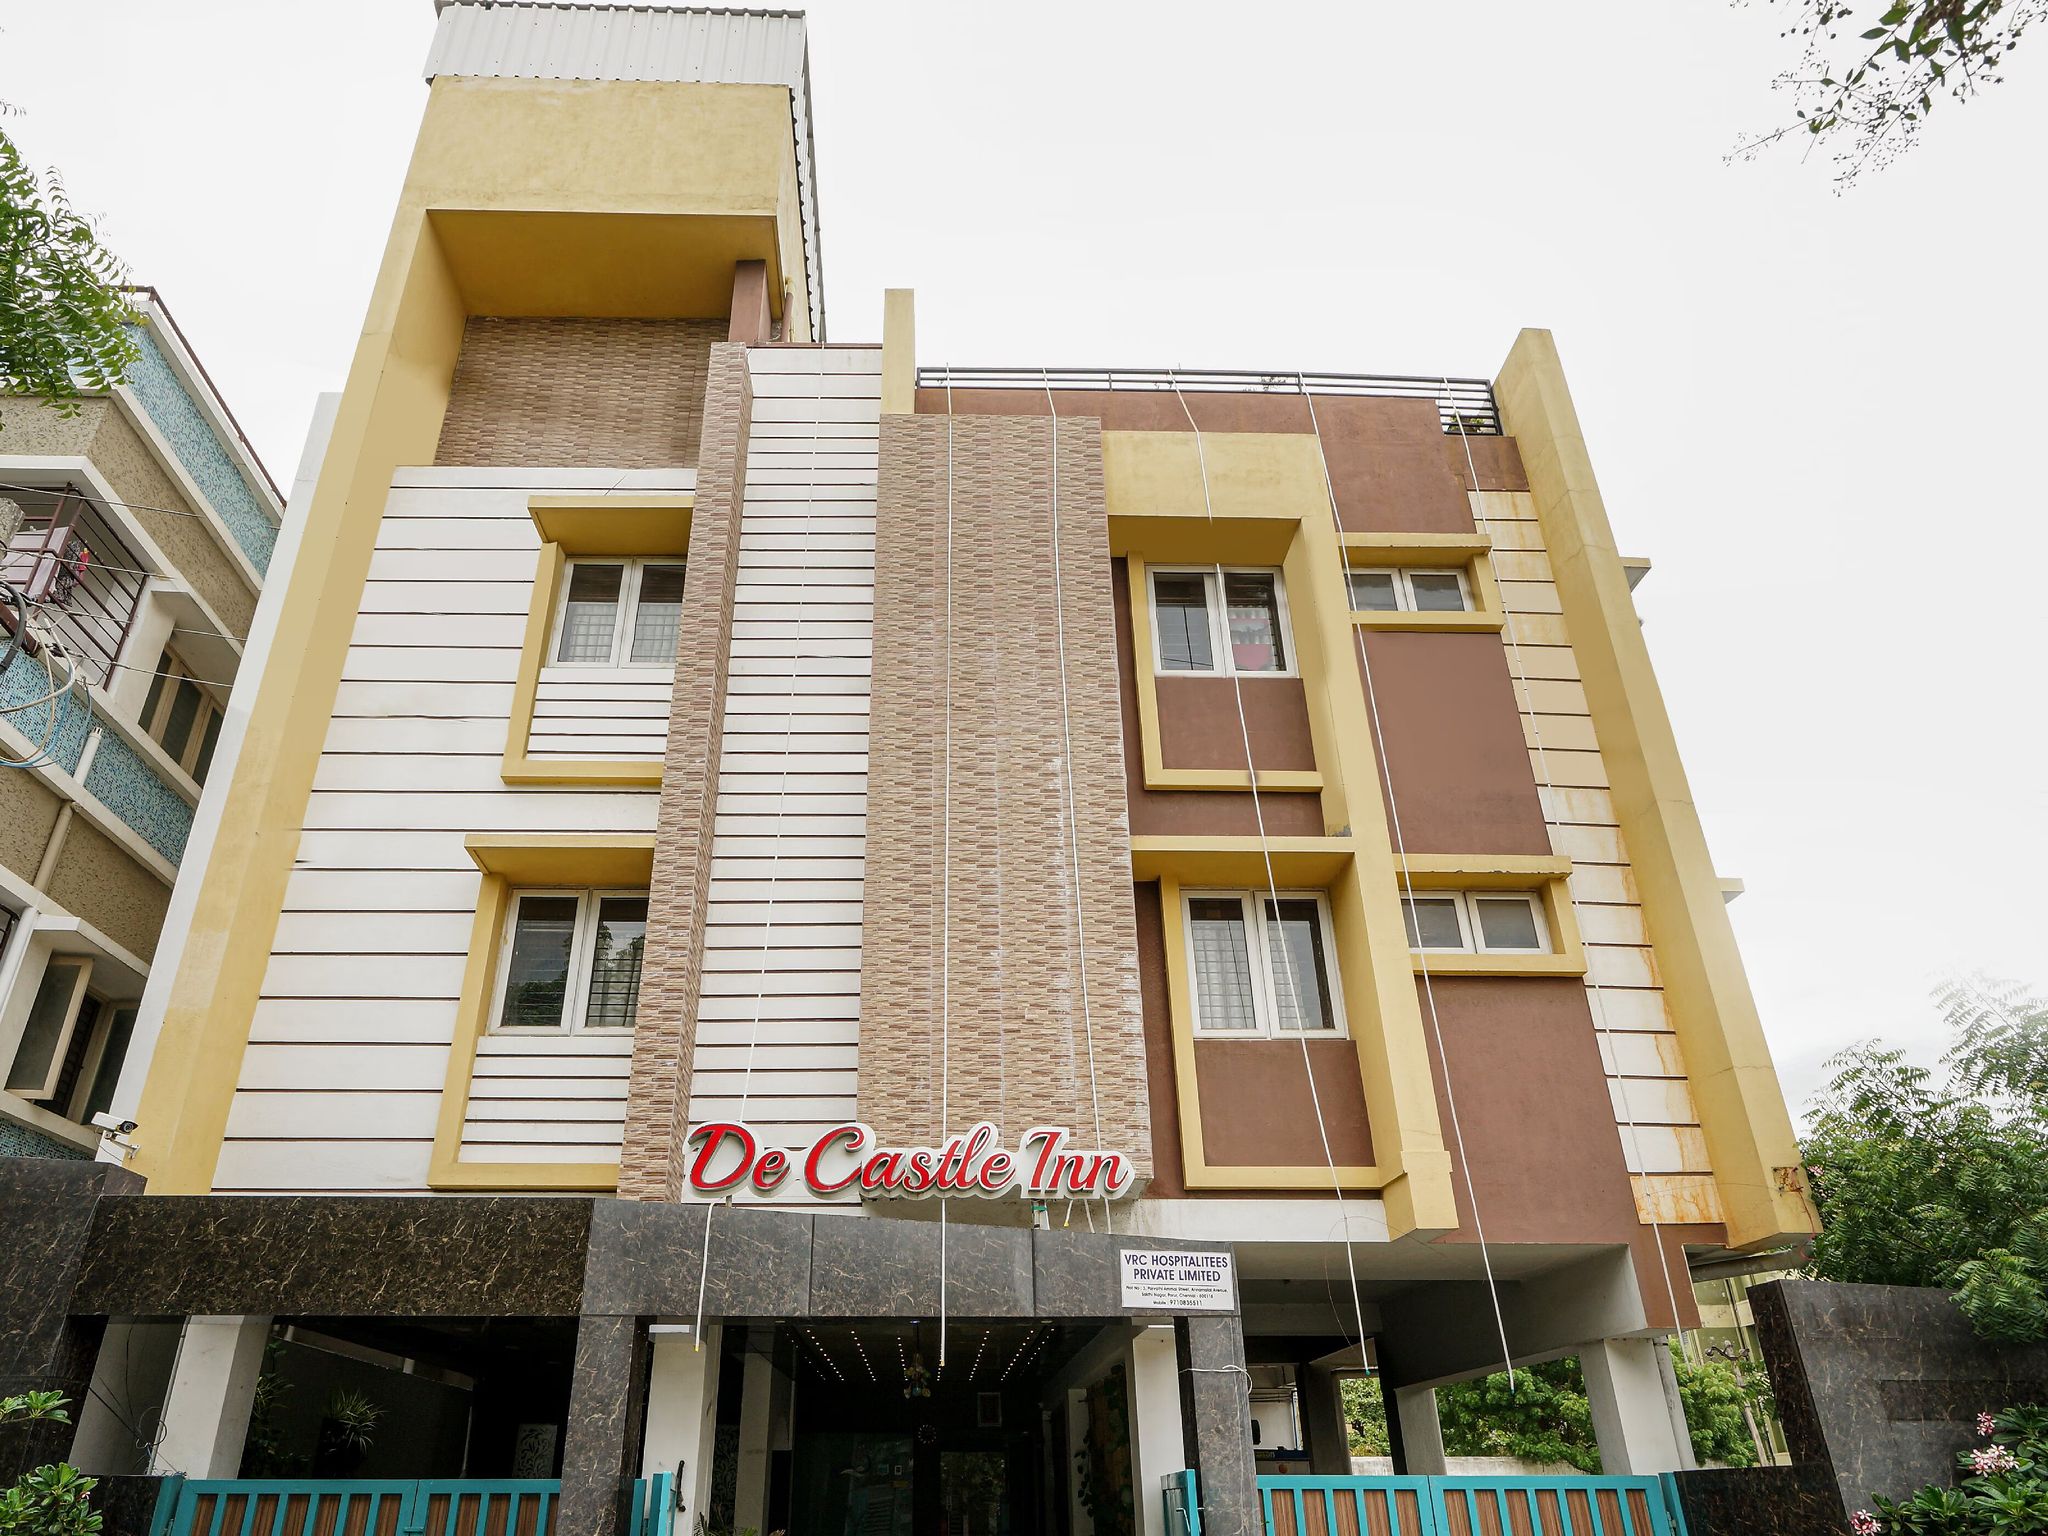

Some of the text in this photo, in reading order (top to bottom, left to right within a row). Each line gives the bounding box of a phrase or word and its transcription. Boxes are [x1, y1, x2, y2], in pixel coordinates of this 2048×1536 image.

[686, 1122, 1129, 1194] De Castle Inn
[1124, 1254, 1228, 1268] VRC HOSPITALITEES
[1133, 1268, 1220, 1281] PRIVATE LIMITED
